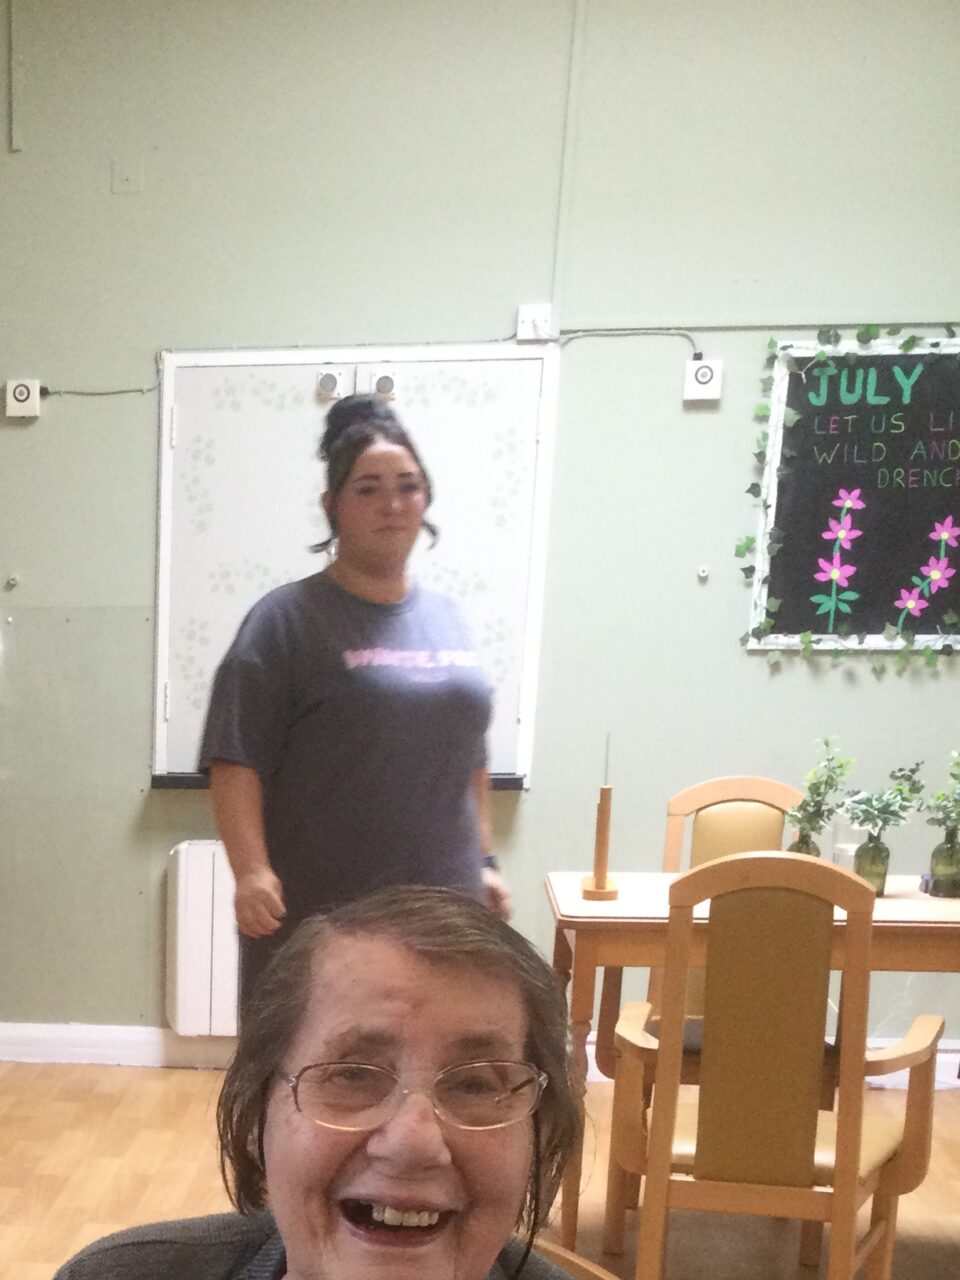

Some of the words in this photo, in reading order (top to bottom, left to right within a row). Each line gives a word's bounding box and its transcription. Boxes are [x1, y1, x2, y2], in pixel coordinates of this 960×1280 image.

[808, 363, 924, 406] JULY
[814, 415, 858, 434] LET
[872, 413, 905, 433] US
[814, 442, 887, 464] WILD
[909, 439, 960, 460] AND
